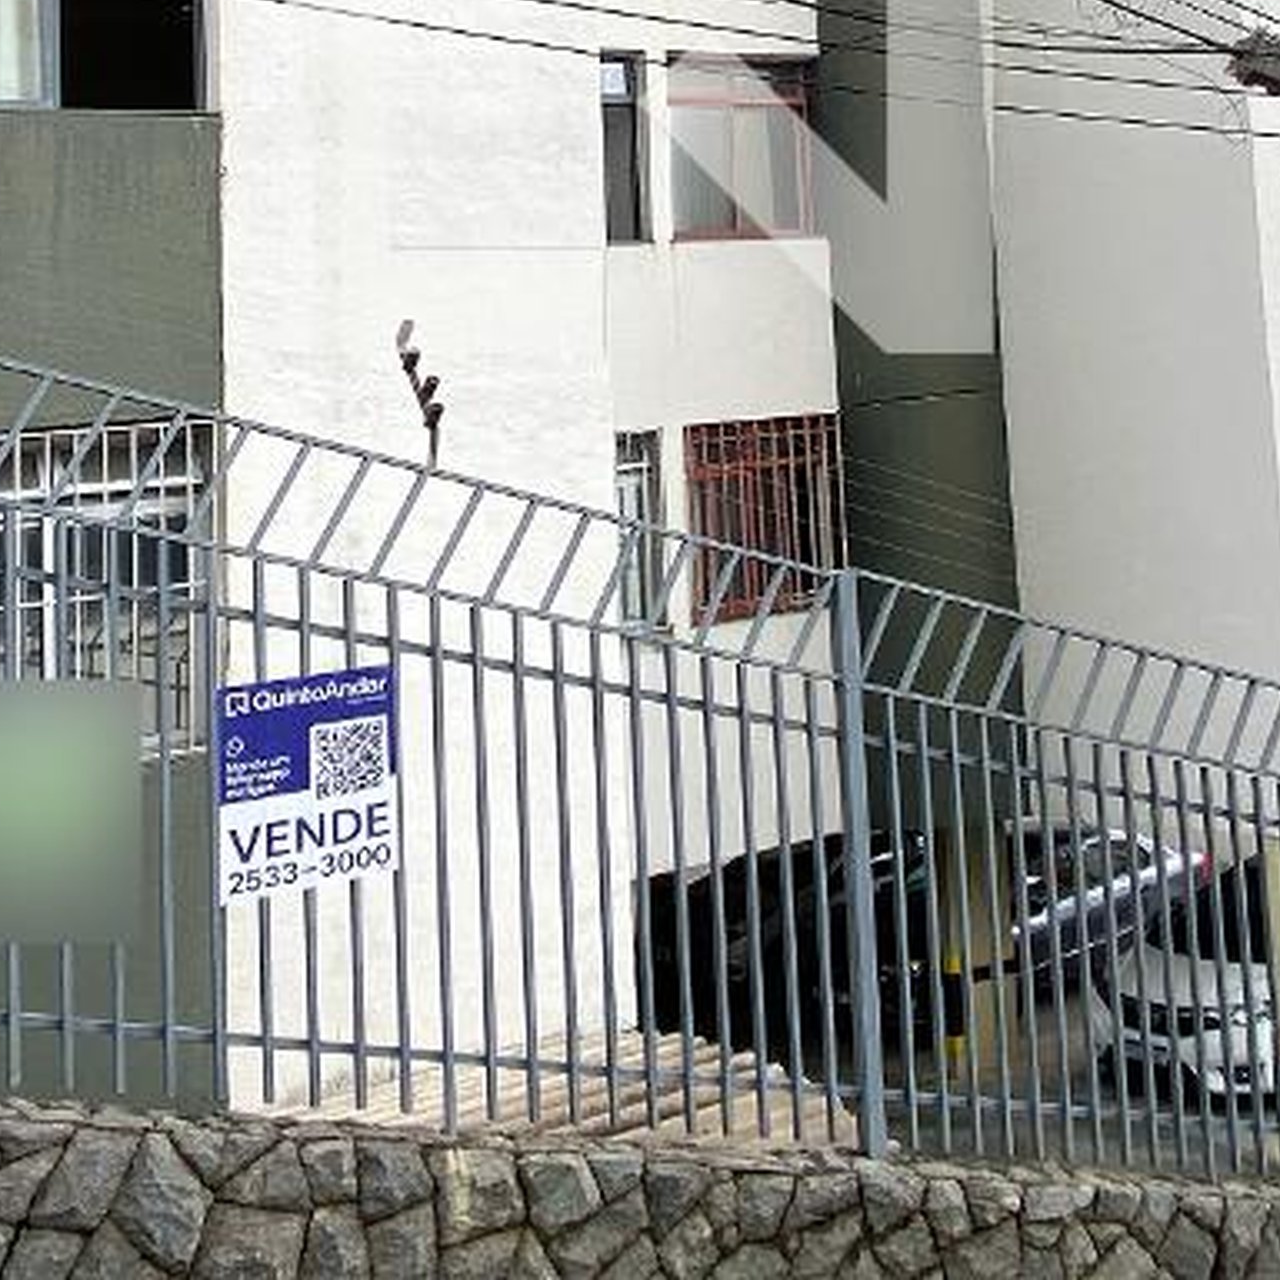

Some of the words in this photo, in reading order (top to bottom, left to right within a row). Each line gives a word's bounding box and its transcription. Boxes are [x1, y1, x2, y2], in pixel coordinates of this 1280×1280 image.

[252, 677, 388, 711] QuintoAndar
[228, 801, 391, 864] VENDE
[228, 842, 392, 896] 2533-3000
